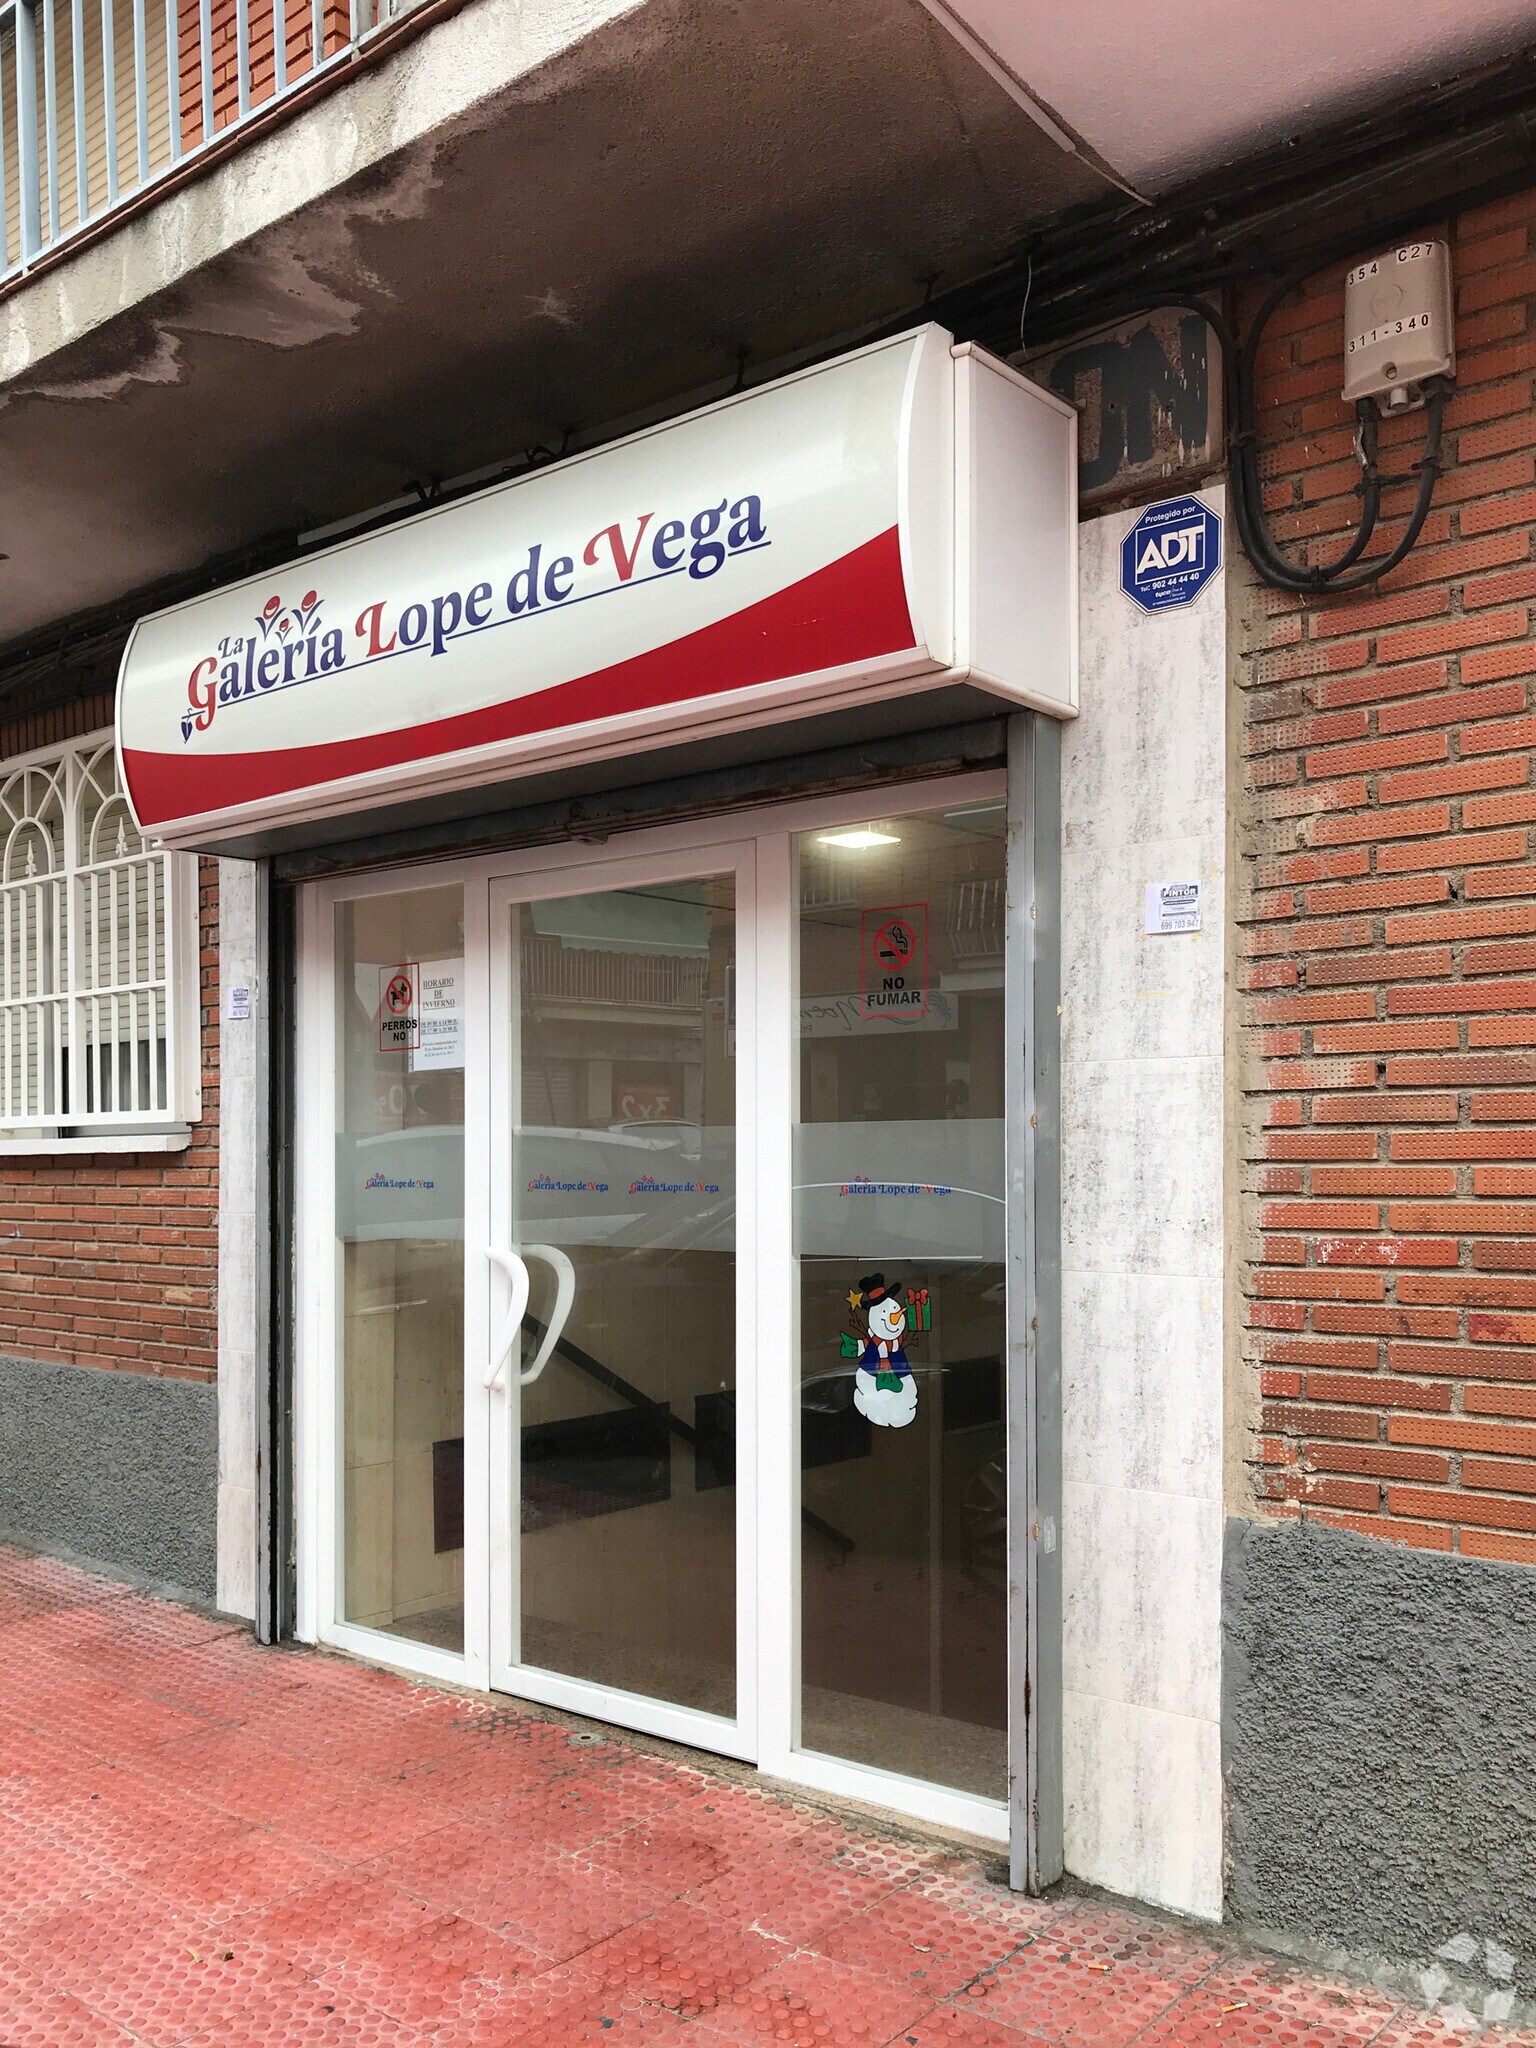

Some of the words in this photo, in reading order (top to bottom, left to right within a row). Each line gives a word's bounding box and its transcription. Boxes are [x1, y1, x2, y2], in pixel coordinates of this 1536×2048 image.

[1349, 263, 1378, 285] 354
[1398, 244, 1433, 262] C27
[1349, 314, 1429, 352] 311-340
[1145, 509, 1181, 523] Protegido
[1182, 506, 1196, 516] por
[1137, 524, 1206, 575] ADT
[1152, 581, 1166, 590] 902
[1167, 577, 1177, 586] 44
[1178, 575, 1188, 584] 44
[1189, 572, 1200, 580] 40
[188, 616, 346, 731] Galería
[355, 582, 492, 657] Lope
[506, 543, 574, 615] de
[583, 495, 767, 580] Vega
[217, 635, 243, 659] La
[1163, 888, 1197, 897] PINTOR
[1174, 920, 1185, 928] 703
[1186, 919, 1199, 928] 947
[423, 977, 455, 988] HORARIO
[883, 977, 905, 990] NO
[433, 989, 443, 998] DE
[867, 990, 921, 1007] FUMAR
[422, 999, 456, 1009] INVIERNO
[382, 1019, 418, 1031] PERROS
[393, 1031, 407, 1041] NO
[389, 1179, 406, 1189] Lope
[407, 1179, 415, 1187] de
[555, 1181, 576, 1192] Lope
[577, 1181, 587, 1191] de
[588, 1181, 609, 1192] Vega
[660, 1182, 683, 1194] Lope
[684, 1182, 695, 1192] de
[696, 1182, 719, 1194] Vega
[878, 1184, 906, 1196] Lope
[908, 1183, 920, 1194] de
[922, 1184, 952, 1196] Vega
